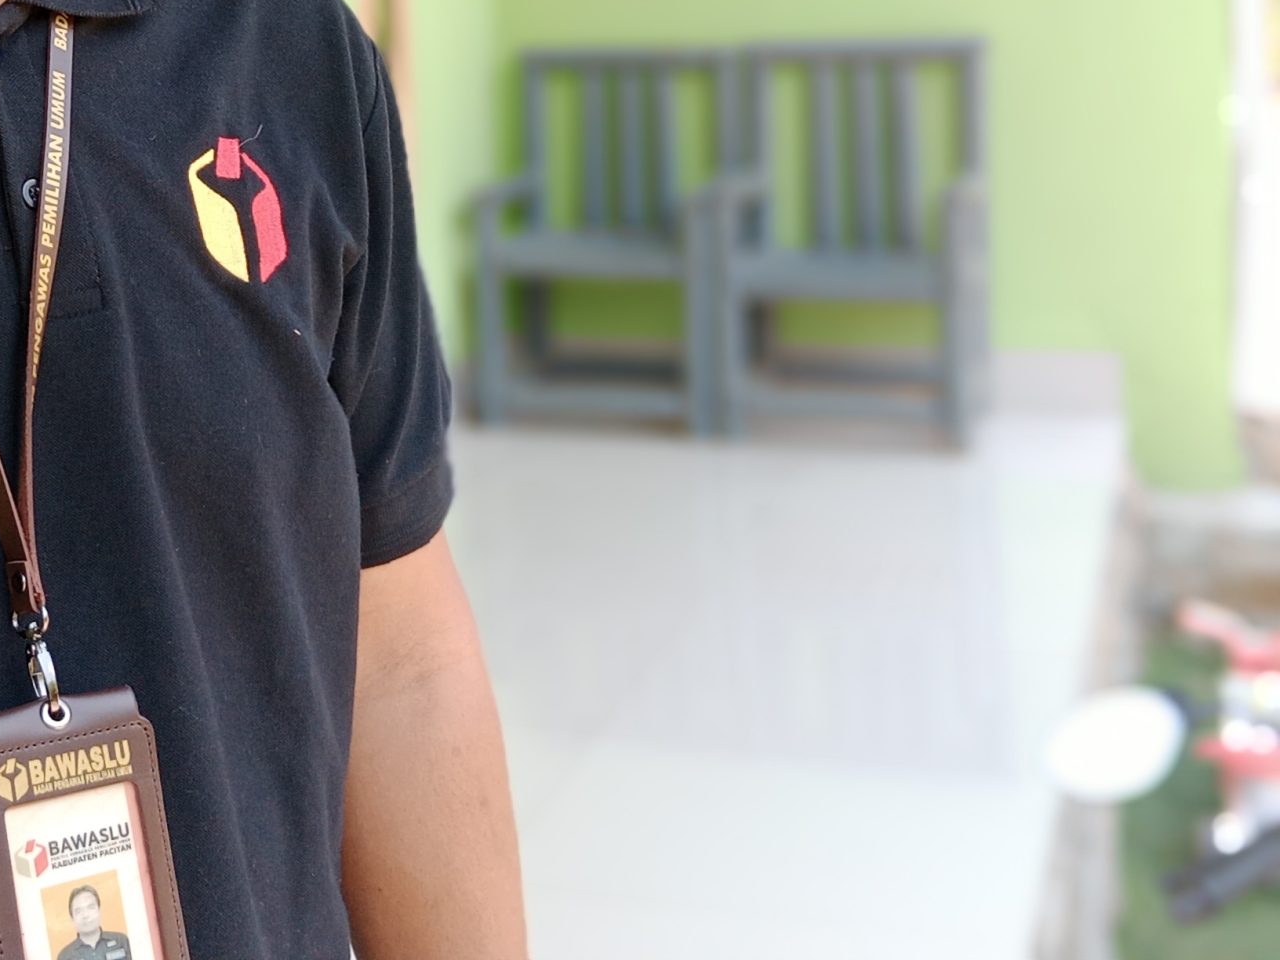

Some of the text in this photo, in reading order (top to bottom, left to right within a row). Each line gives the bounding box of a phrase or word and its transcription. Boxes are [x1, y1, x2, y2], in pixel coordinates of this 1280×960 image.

[53, 12, 69, 51] BAD
[50, 71, 66, 130] UMUM
[41, 134, 63, 248] PEMILIHAN
[28, 739, 131, 785] BAWASLU
[48, 821, 130, 857] BAWASLU
[51, 851, 99, 870] KABUPATEN
[99, 843, 132, 858] PACITAN
